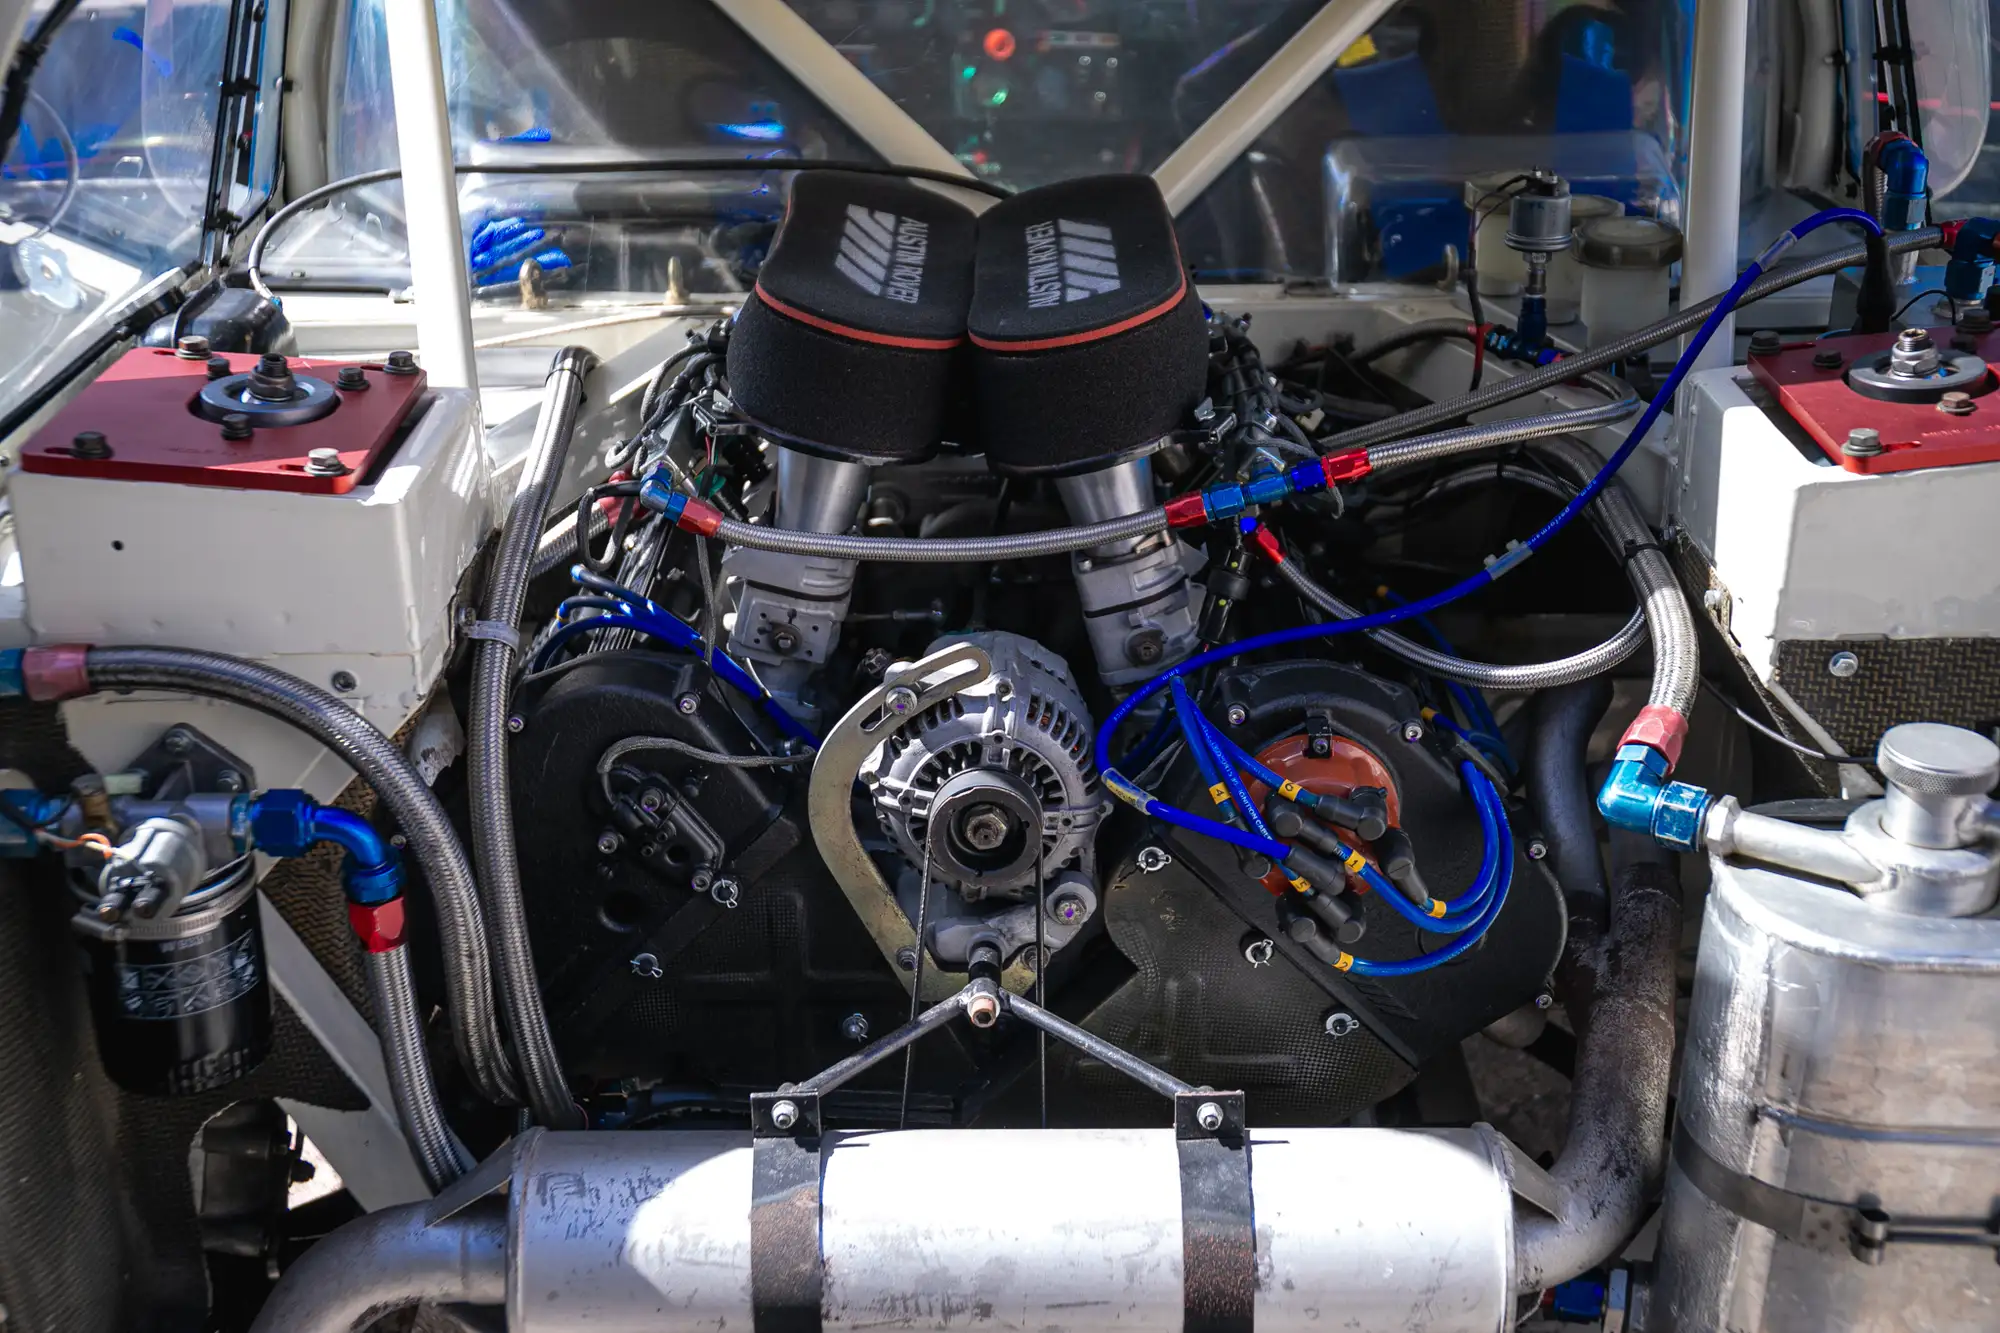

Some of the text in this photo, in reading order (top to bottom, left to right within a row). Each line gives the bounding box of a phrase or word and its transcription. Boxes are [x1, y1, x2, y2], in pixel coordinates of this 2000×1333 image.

[887, 216, 929, 304] AUSTIN ROVER
[1025, 220, 1062, 308] AUSTIN ROVER
[1525, 505, 1570, 546] performanc
[1214, 788, 1225, 797] 4
[1284, 781, 1294, 792] 6
[1237, 788, 1259, 820] IGNITION
[1349, 858, 1359, 869] 1
